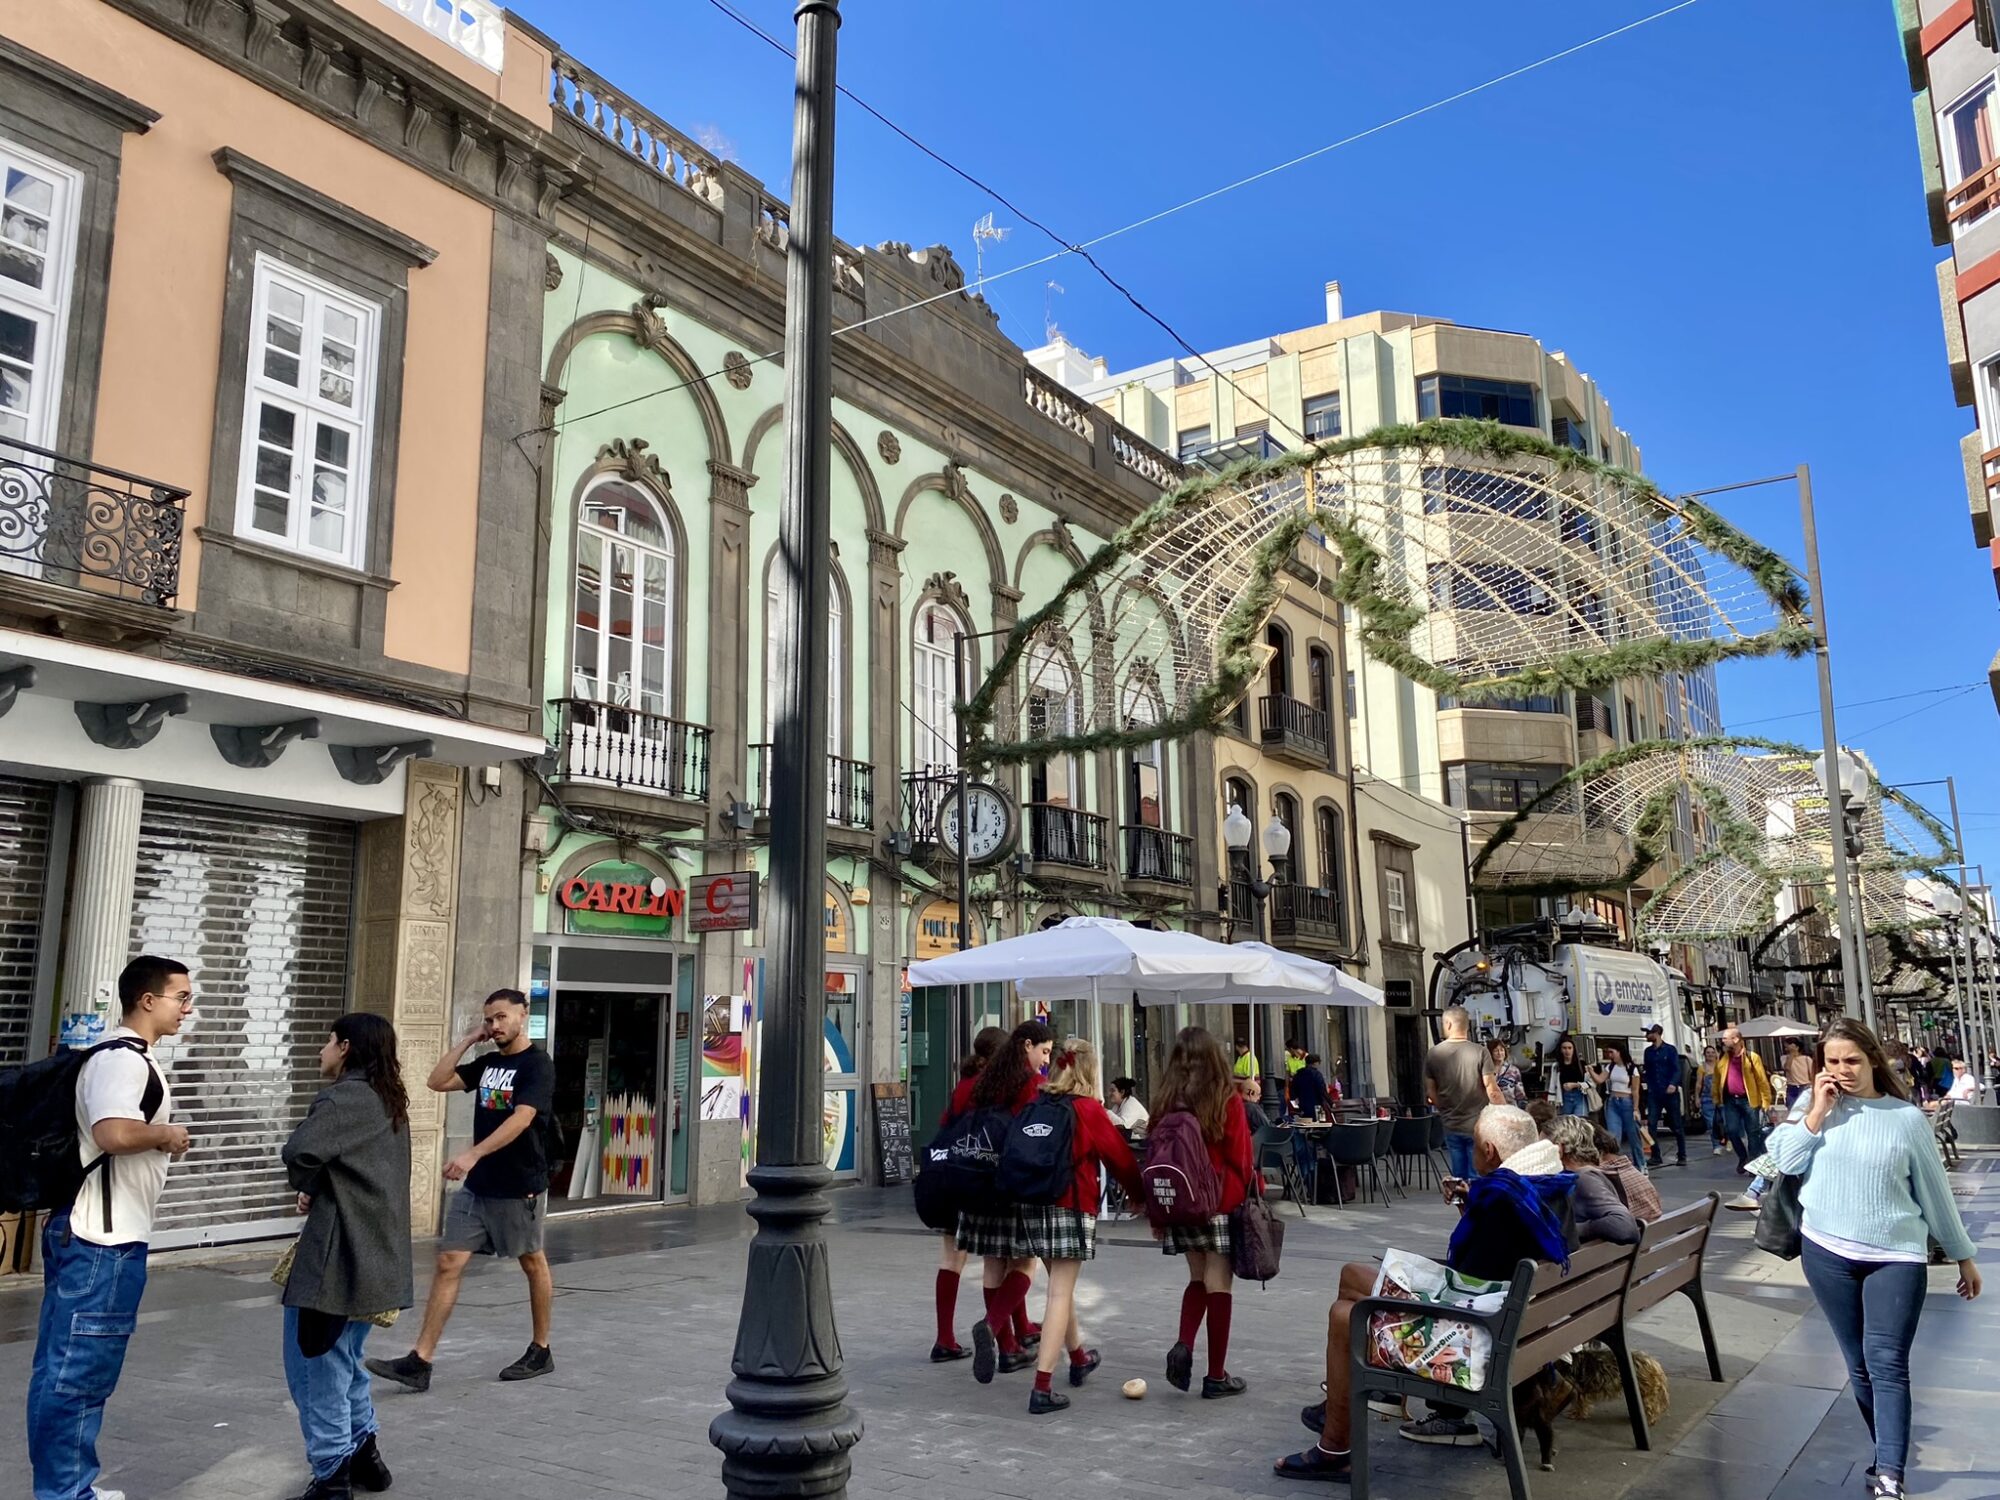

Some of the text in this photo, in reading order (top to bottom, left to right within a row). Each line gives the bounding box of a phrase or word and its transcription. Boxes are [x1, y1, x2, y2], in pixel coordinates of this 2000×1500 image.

[983, 798, 987, 807] 1
[991, 804, 998, 815] 2
[950, 821, 957, 832] 9
[994, 816, 1001, 827] 3
[991, 830, 998, 839] 4
[973, 843, 980, 853] 6
[983, 839, 990, 849] 5
[706, 877, 734, 914] C
[951, 919, 976, 940] PÉ
[1615, 974, 1653, 1002] emalsa
